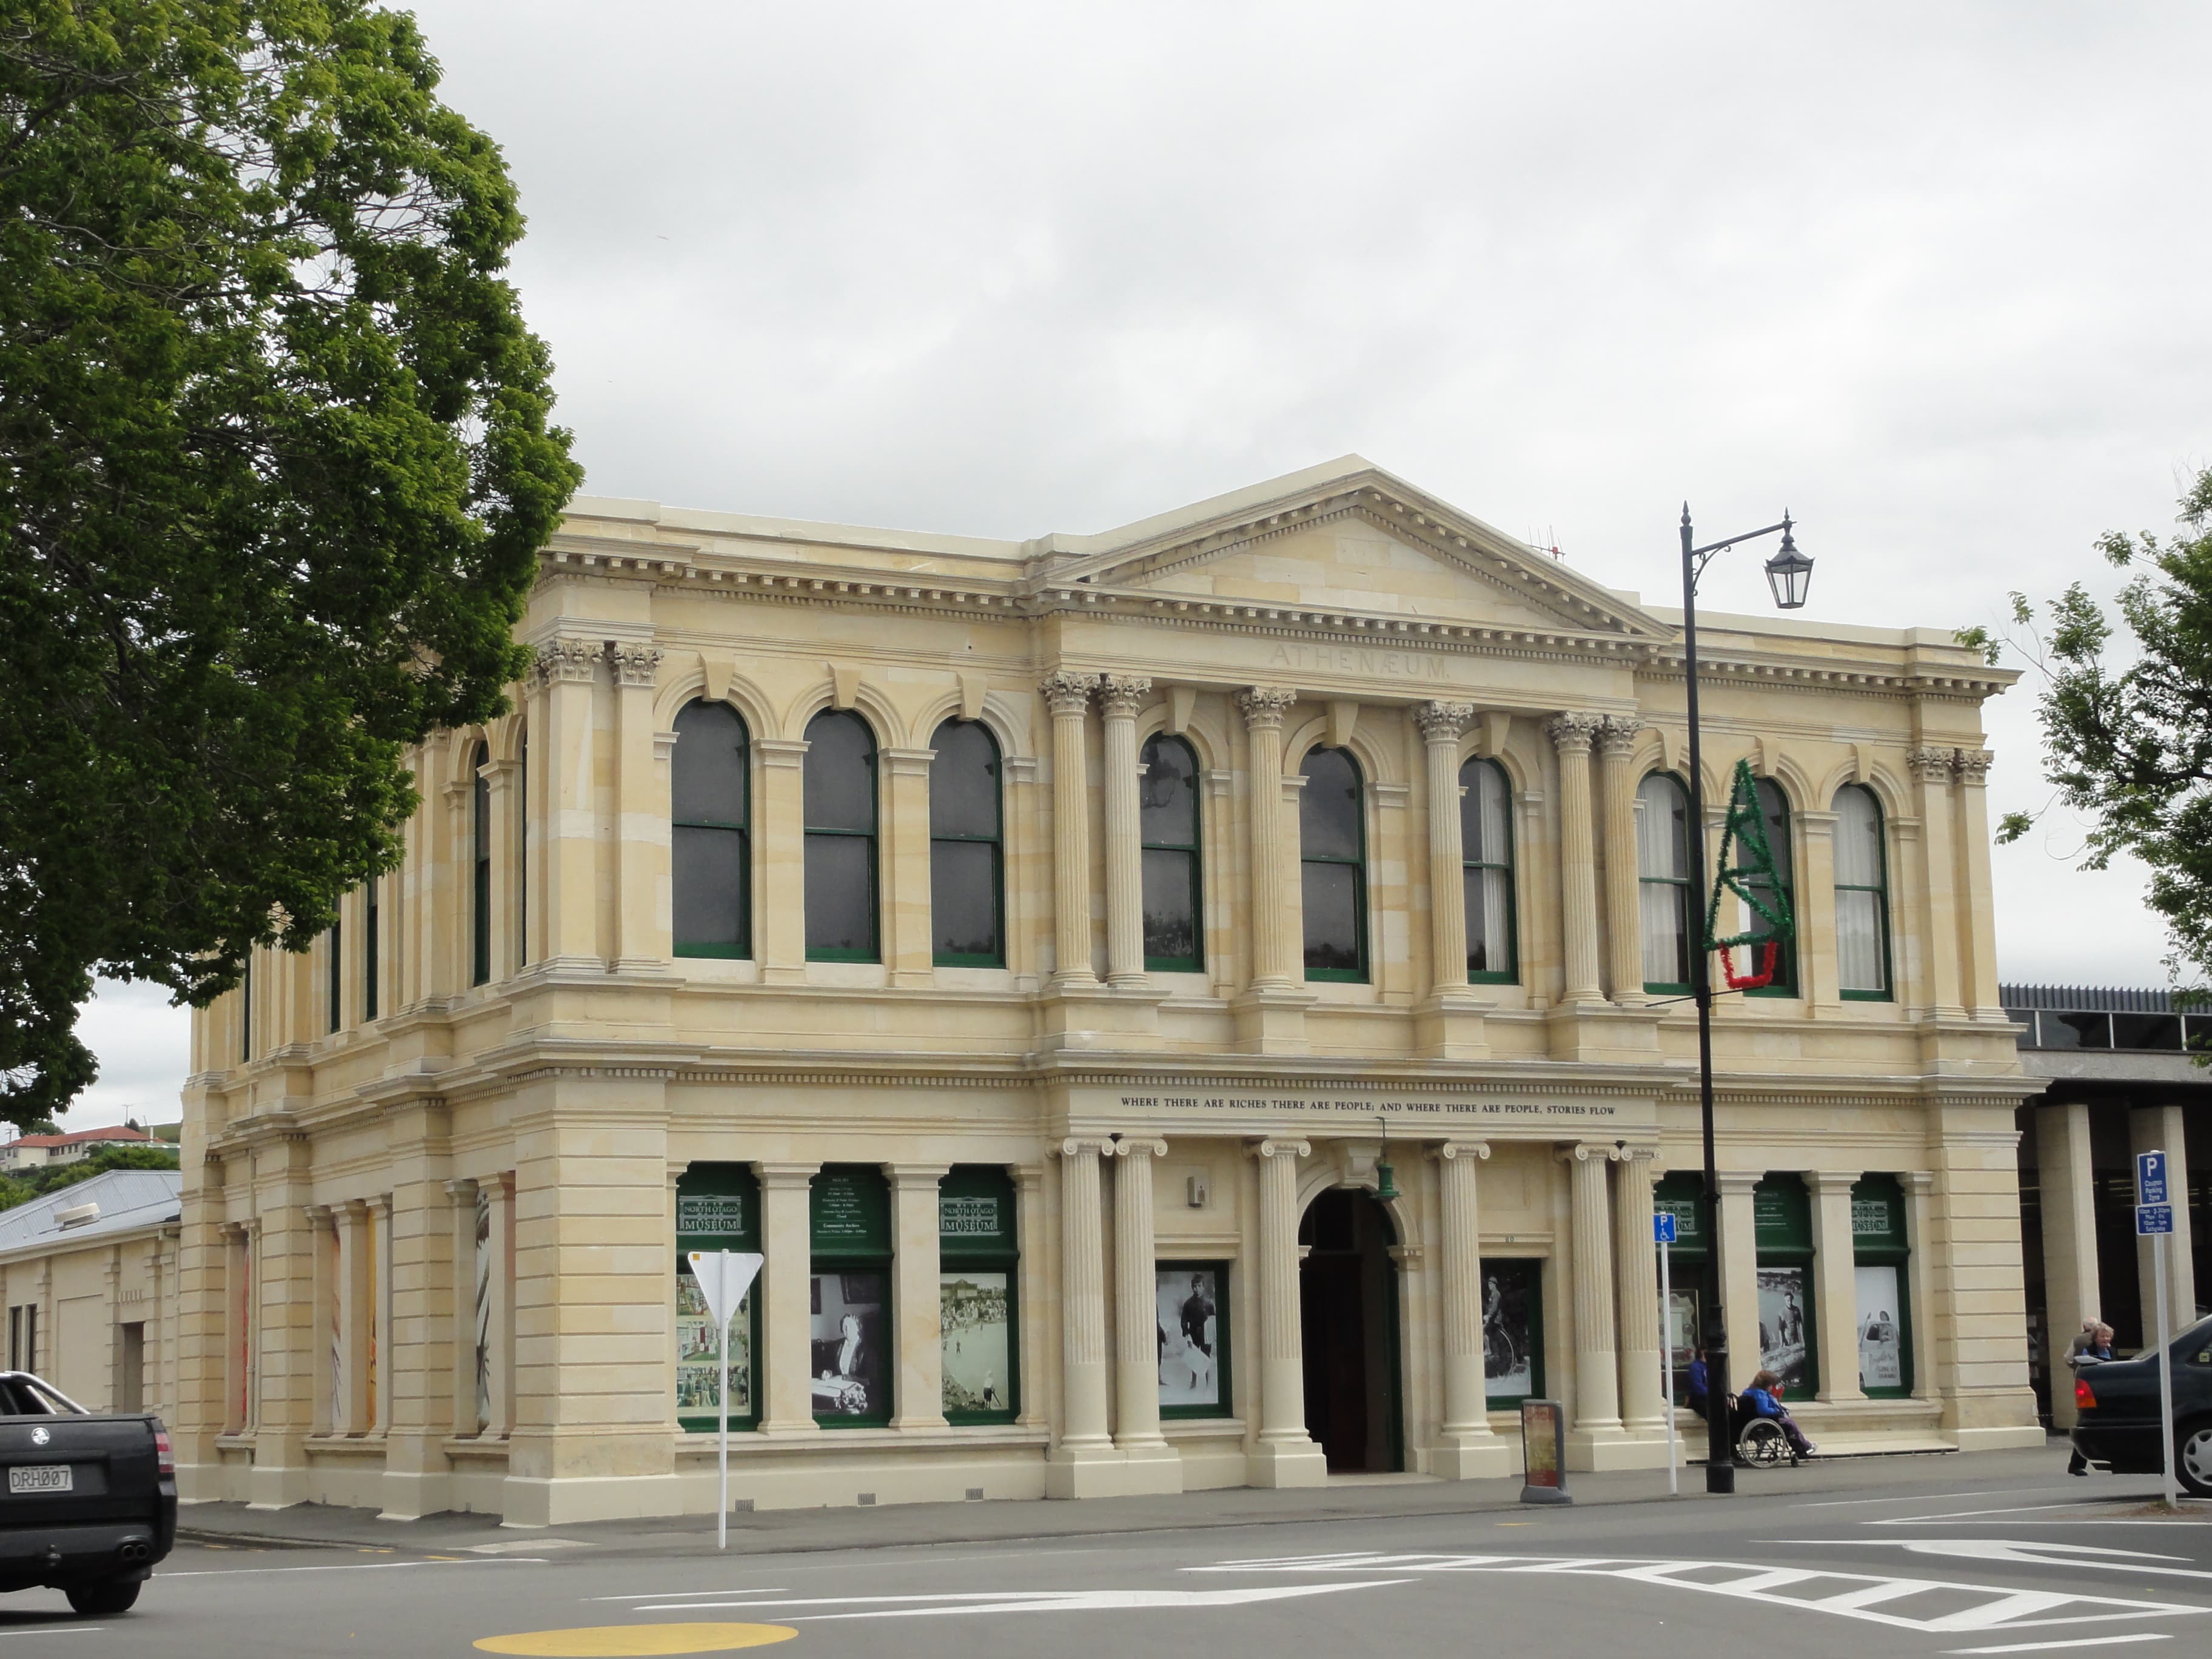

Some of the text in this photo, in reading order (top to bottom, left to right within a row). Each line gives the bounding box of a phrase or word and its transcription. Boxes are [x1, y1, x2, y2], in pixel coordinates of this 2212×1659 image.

[1122, 1098, 1158, 1106] WHERE
[1164, 1098, 1198, 1107] THERE
[1204, 1099, 1224, 1107] ARE
[1230, 1099, 1267, 1108] RICHES
[1272, 1100, 1305, 1109] THERE
[1310, 1101, 1330, 1110] ARE
[1380, 1102, 1401, 1111] AND
[1406, 1103, 1441, 1112] WHERE
[1446, 1104, 1477, 1113] THERE
[1482, 1104, 1501, 1113] ARE
[1505, 1105, 1542, 1114] PEOPLE,
[1547, 1105, 1586, 1114] STORIES
[1590, 1107, 1615, 1115] FLOW
[2147, 1157, 2157, 1176] P
[685, 1221, 737, 1230] MUSEUM
[945, 1222, 994, 1230] MUSEUM
[1661, 1216, 1667, 1226] P
[12, 1470, 69, 1487] DRH007
